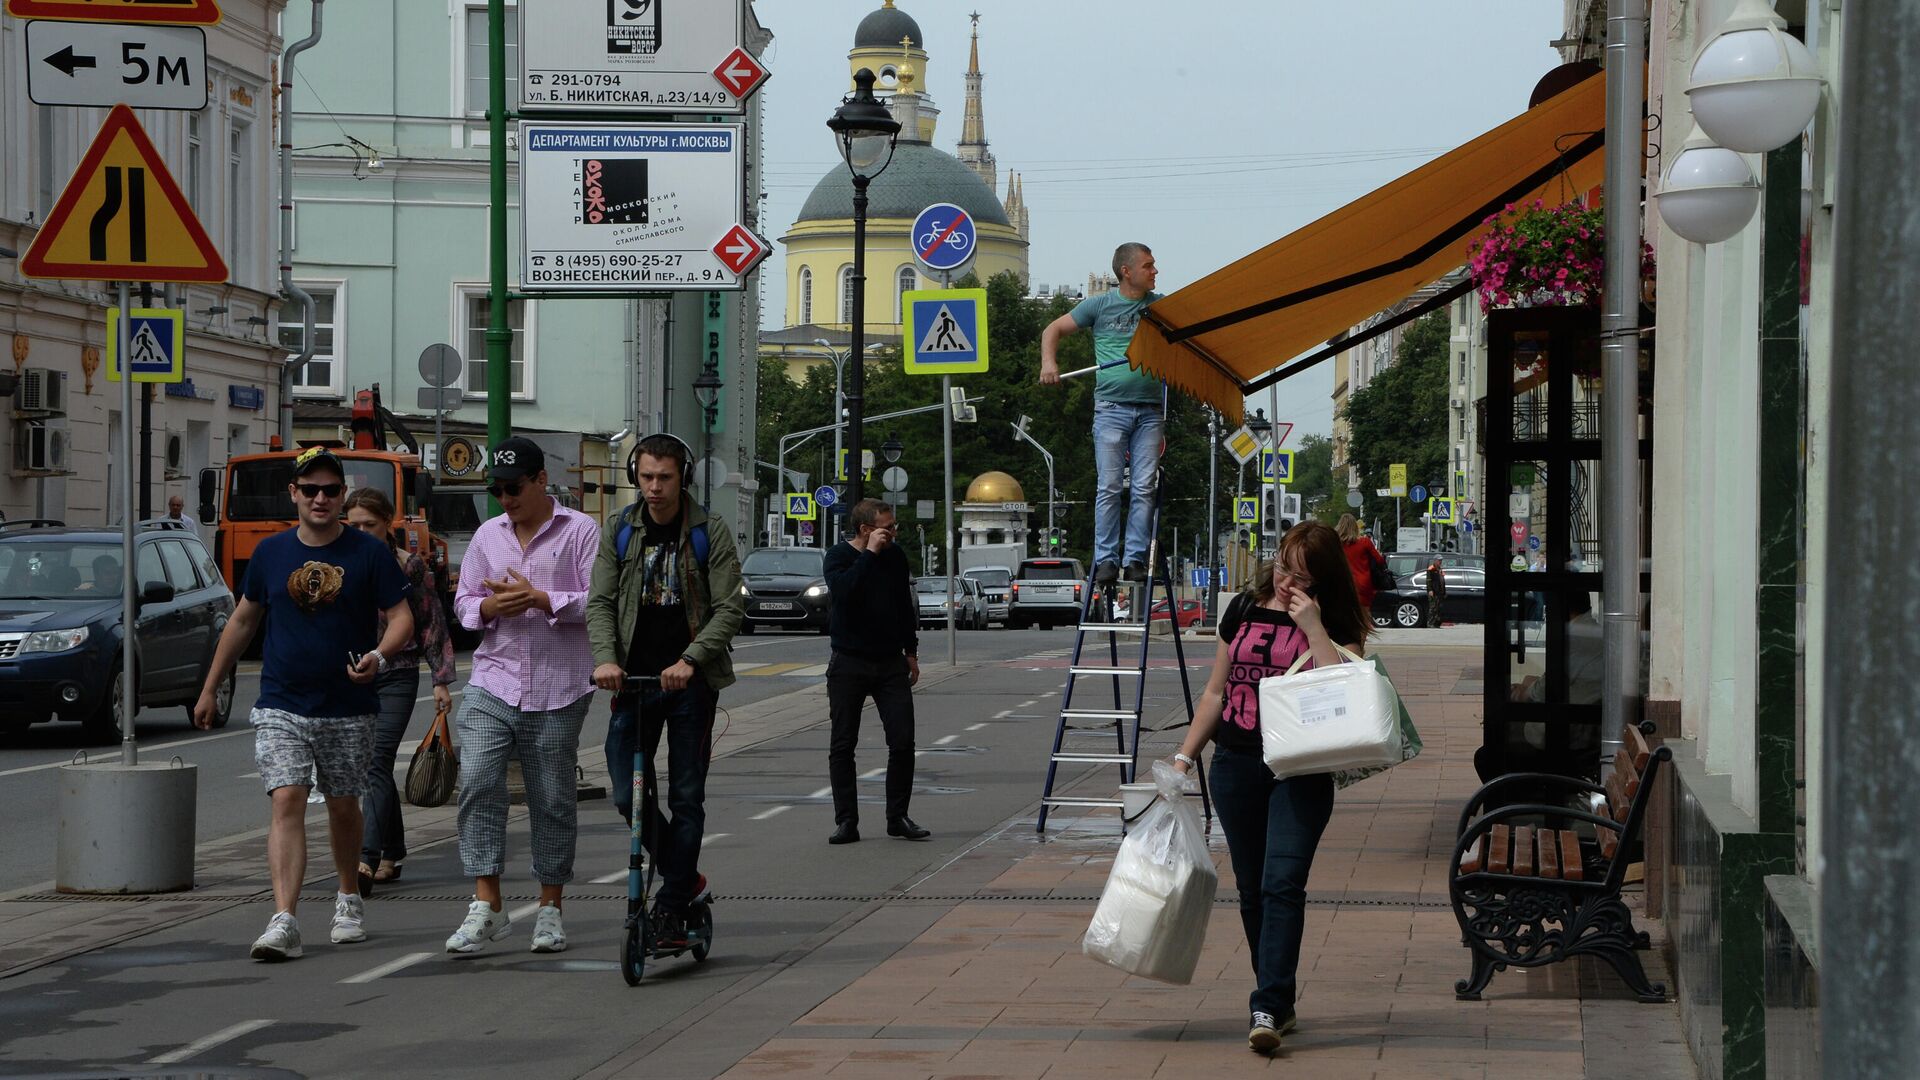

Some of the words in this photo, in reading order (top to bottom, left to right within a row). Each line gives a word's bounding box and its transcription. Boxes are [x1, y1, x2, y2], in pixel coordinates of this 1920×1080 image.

[608, 26, 655, 39] НИКИТСКИХ
[631, 40, 655, 53] ВОРОТ
[552, 74, 621, 86] 291-0794
[551, 90, 563, 101] Б.
[568, 90, 653, 103] НИКИТСКАЯ,
[533, 134, 610, 148] ДЕПАРТАМЕНТ
[614, 135, 668, 148] КУЛЬТУРЫ
[672, 136, 729, 148] г.МОСКВЫ
[573, 159, 581, 224] ТЕАТР
[607, 192, 676, 213] МОСКОВСКИЙ
[613, 224, 647, 236] ОКОЛО
[653, 216, 681, 228] ДОМА
[615, 225, 685, 246] СТАНИСЛАВСКОГО
[555, 255, 564, 266] 8
[568, 255, 606, 268] (495)
[610, 255, 683, 266] 690-25-27
[532, 267, 651, 281] ВОЗНЕСЕНСКИЙ
[703, 269, 711, 281] 9
[715, 270, 724, 281] А
